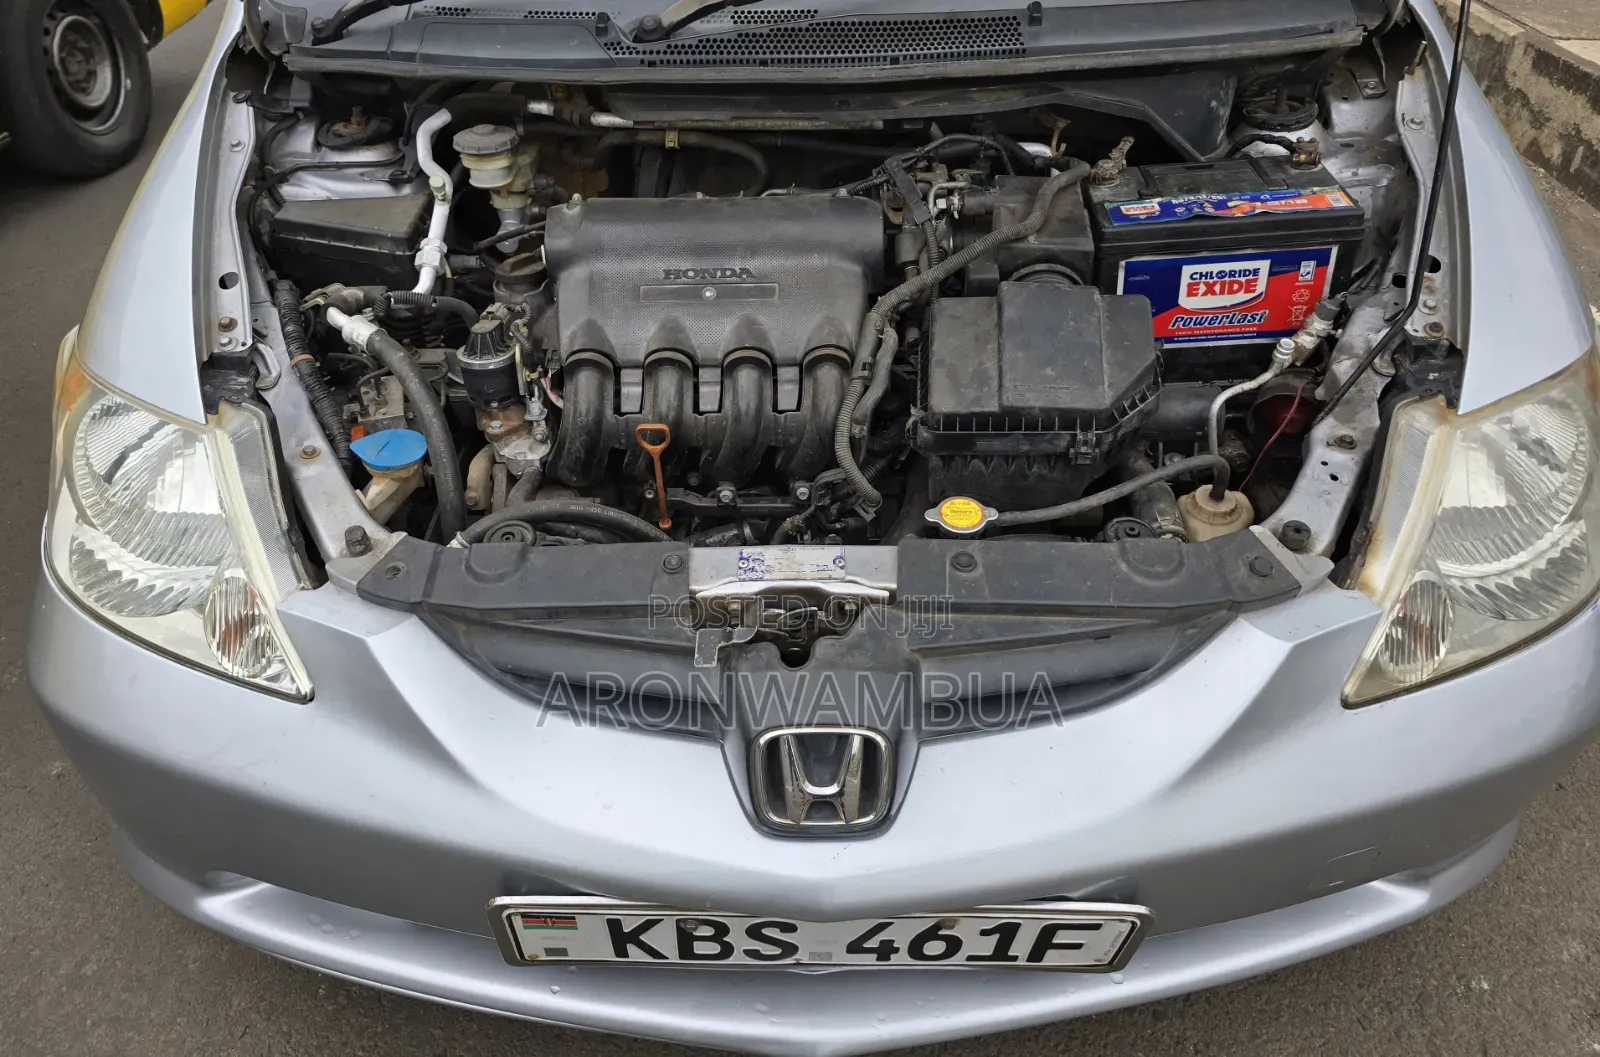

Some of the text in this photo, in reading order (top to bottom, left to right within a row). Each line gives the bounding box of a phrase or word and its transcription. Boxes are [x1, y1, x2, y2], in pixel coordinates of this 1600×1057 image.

[661, 267, 757, 280] HONDA
[1189, 267, 1261, 281] CHLORIDE
[1186, 277, 1259, 298] EXIDE
[1168, 310, 1269, 329] PowerLast
[605, 917, 800, 962] KBS
[845, 921, 1104, 963] 461F
